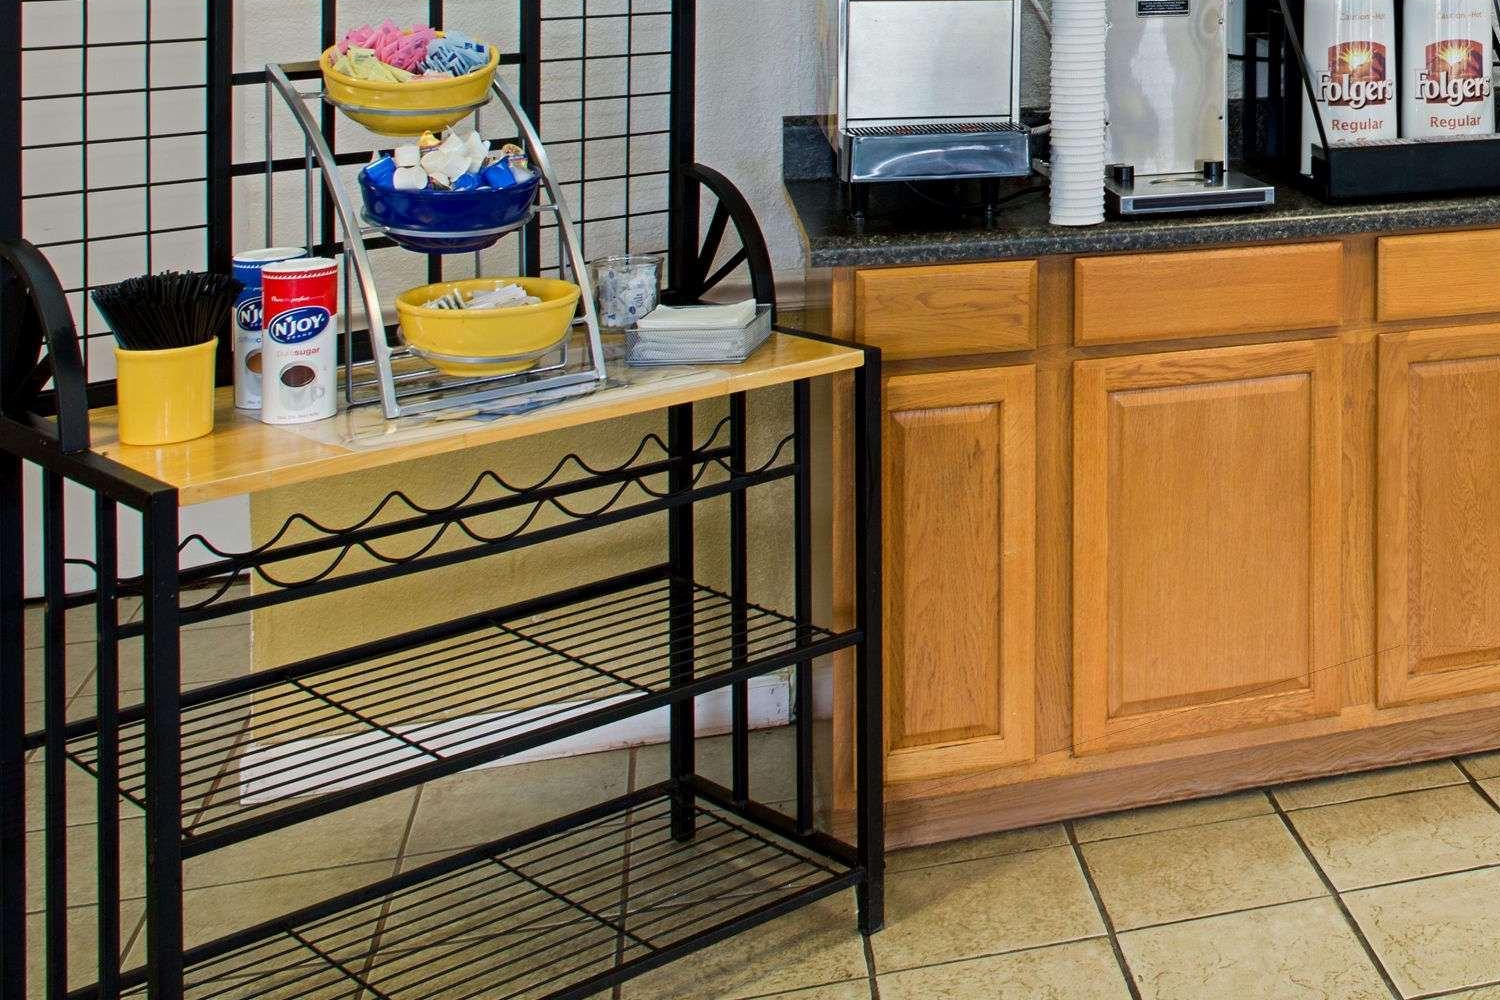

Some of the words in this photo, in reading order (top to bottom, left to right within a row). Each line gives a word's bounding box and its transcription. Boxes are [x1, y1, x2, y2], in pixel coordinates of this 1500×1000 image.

[1315, 70, 1394, 110] Folgers
[1414, 68, 1491, 107] Folgers
[1332, 119, 1384, 134] Regular
[1430, 115, 1481, 130] Regular
